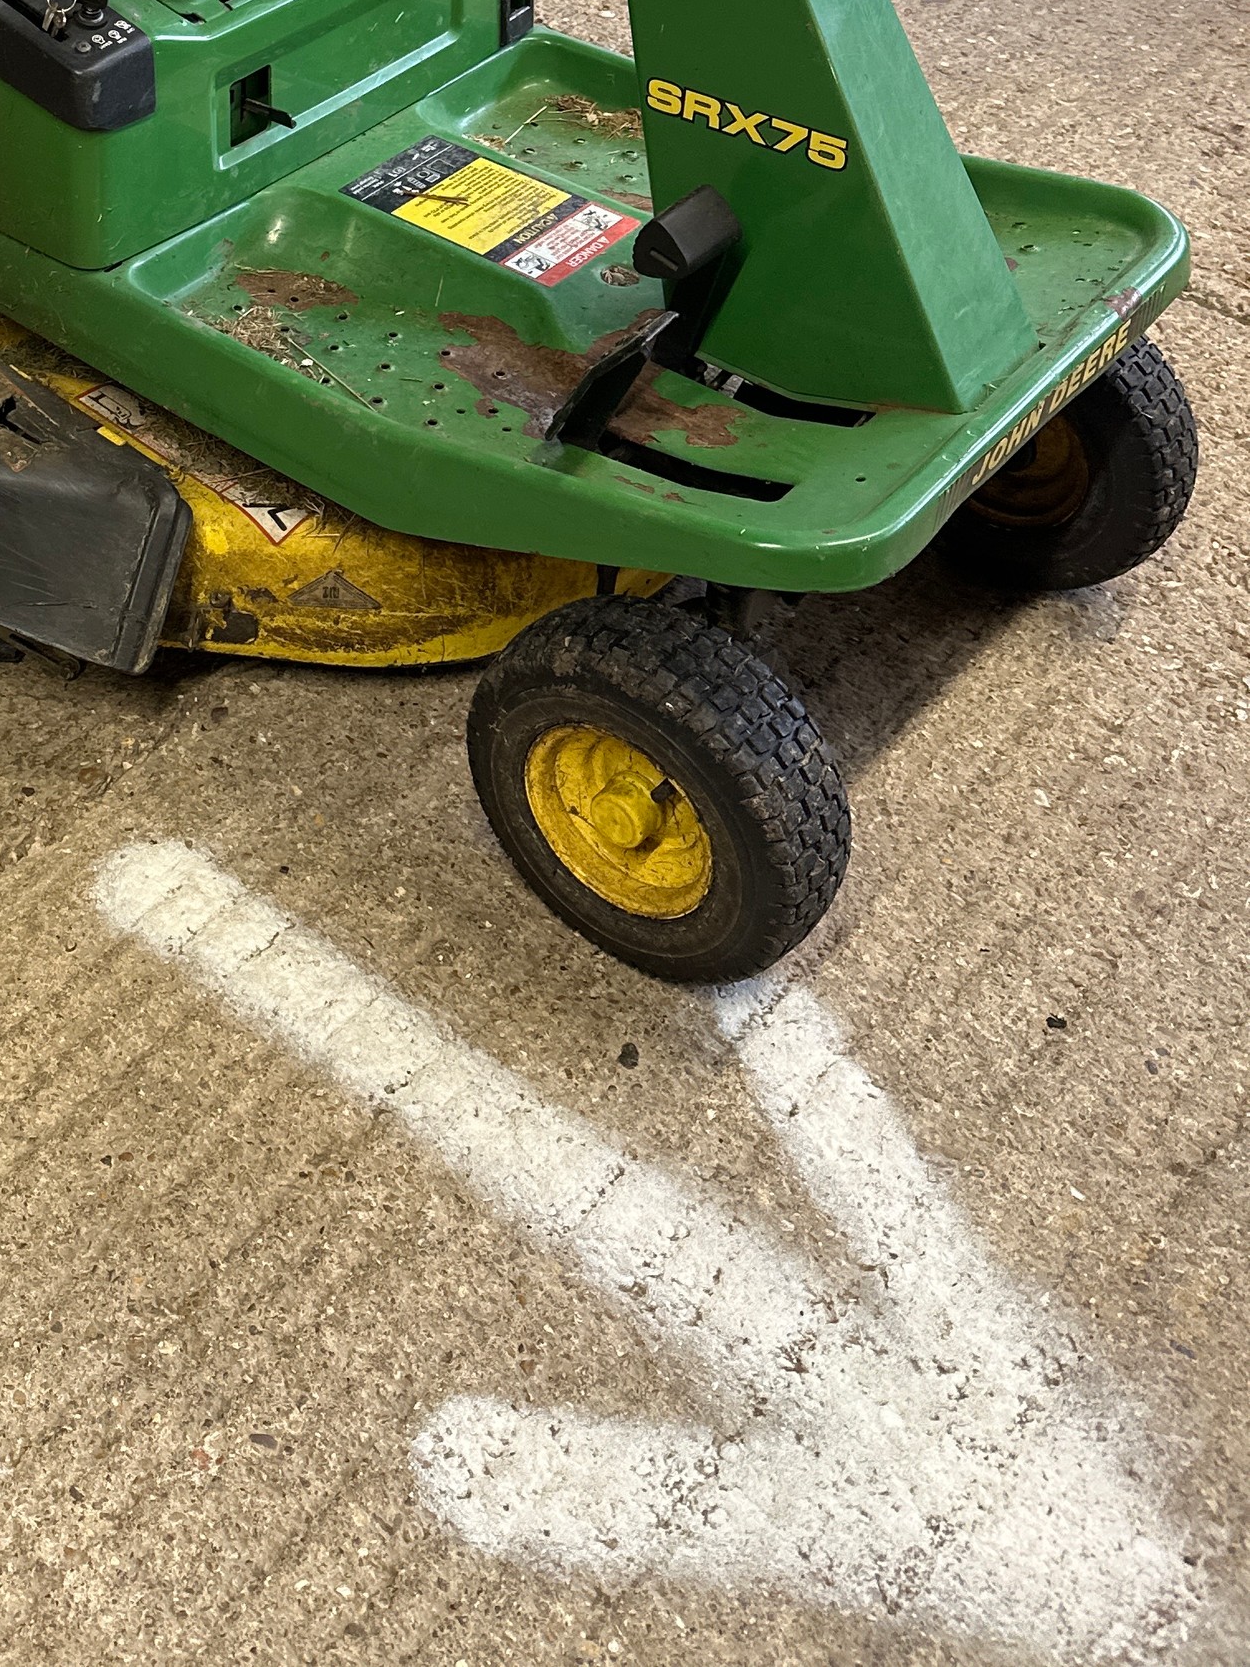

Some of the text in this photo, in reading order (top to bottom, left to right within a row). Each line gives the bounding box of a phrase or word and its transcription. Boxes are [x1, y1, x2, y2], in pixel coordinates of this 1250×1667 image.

[647, 77, 849, 172] SRX75
[513, 214, 548, 244] CAUTION
[565, 242, 602, 268] DANGER
[972, 319, 1132, 486] JOHN DEERE
